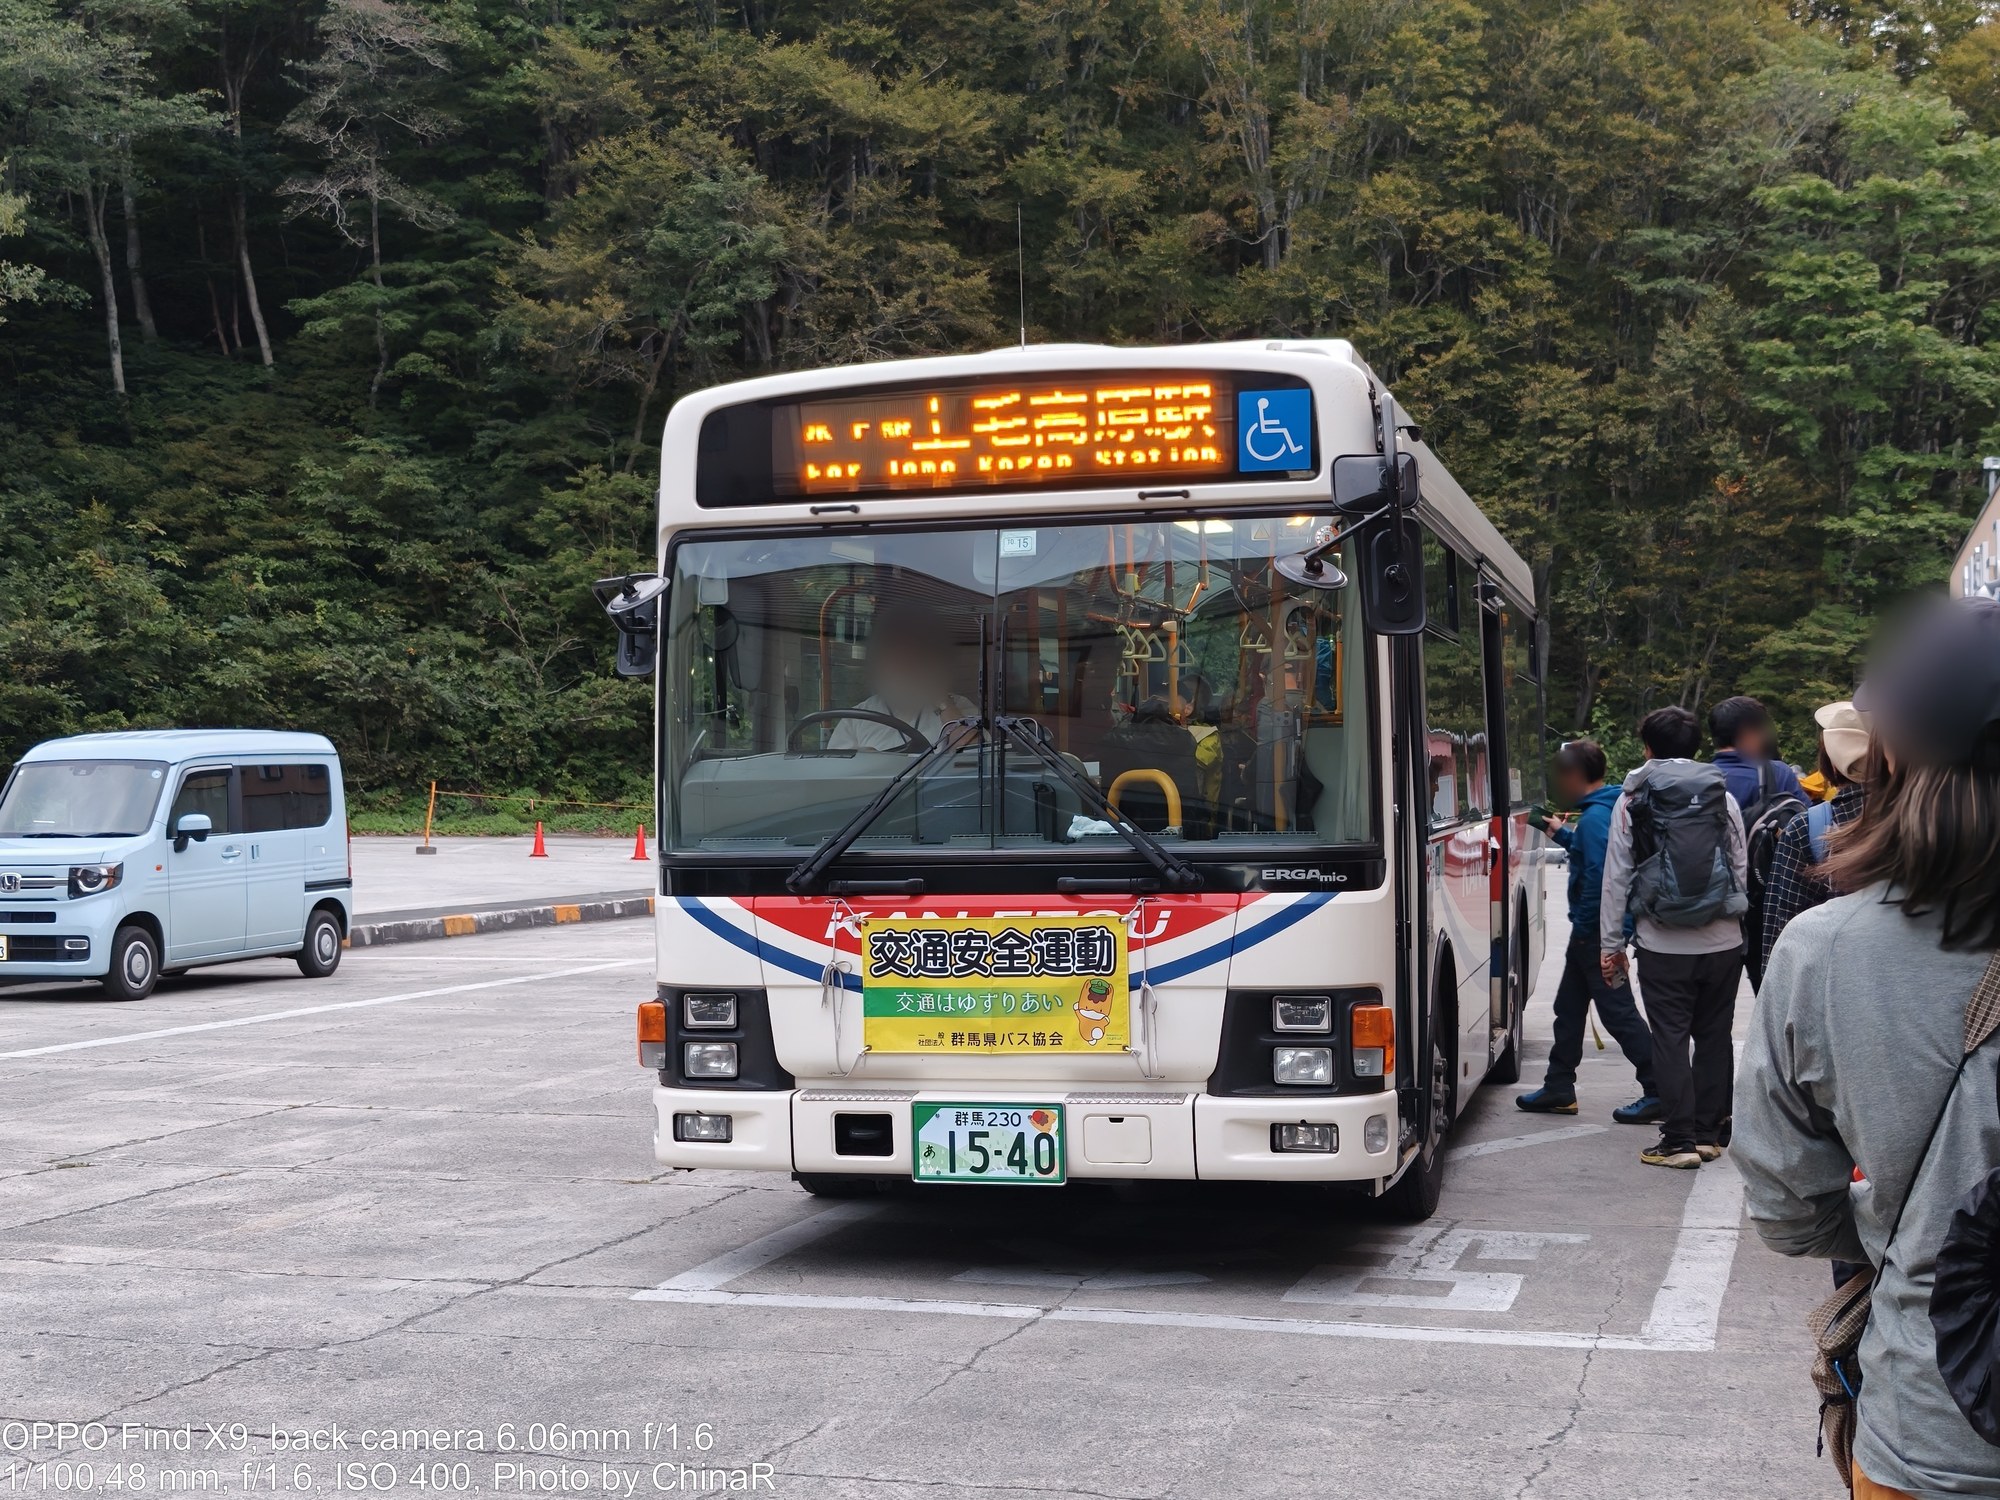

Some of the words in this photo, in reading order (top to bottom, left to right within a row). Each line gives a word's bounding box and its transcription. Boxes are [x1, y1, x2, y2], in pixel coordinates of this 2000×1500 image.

[869, 926, 1117, 979] 交通安全運動
[895, 992, 1064, 1014] 交通はゆずりあい
[950, 1031, 1064, 1047] 群馬県バス協会
[923, 1144, 936, 1159] あ
[948, 1130, 1056, 1176] 15-40
